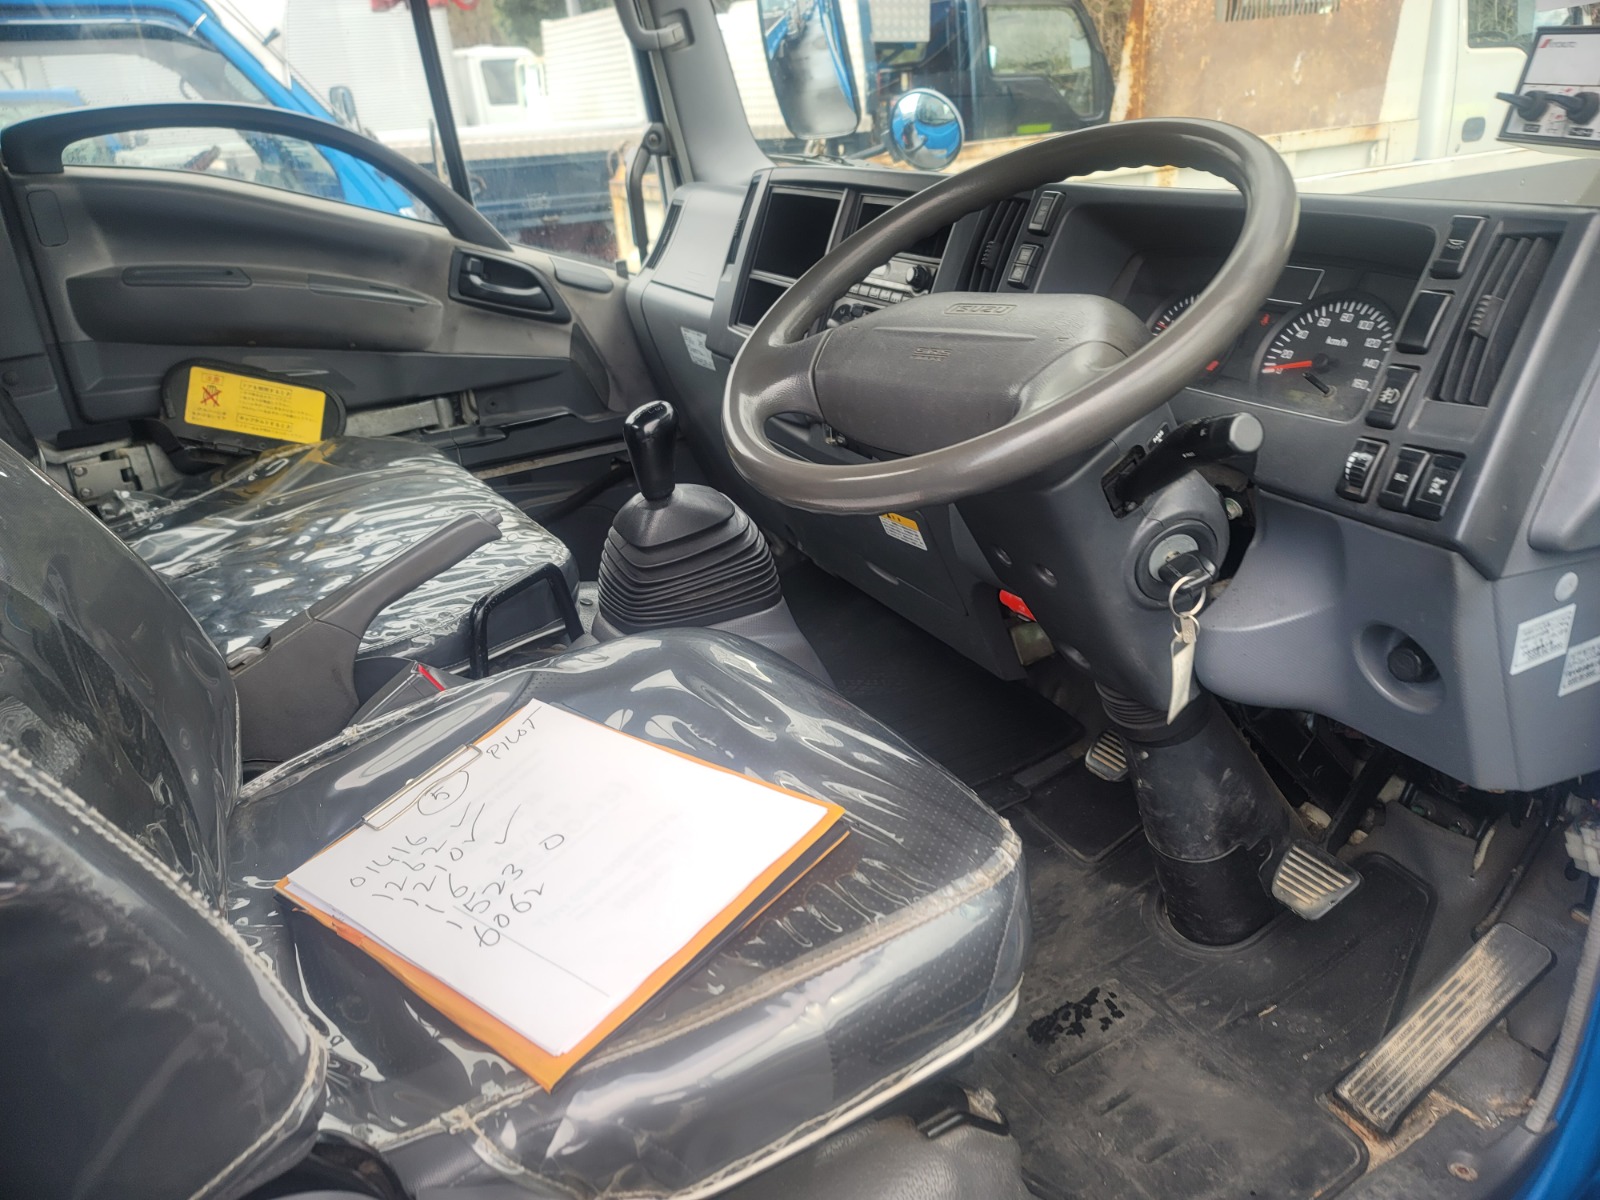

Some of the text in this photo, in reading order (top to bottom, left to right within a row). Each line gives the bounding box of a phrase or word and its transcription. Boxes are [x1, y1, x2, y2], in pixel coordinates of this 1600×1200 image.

[955, 305, 1009, 314] ISUZU
[1317, 318, 1331, 327] 60
[1340, 313, 1354, 322] 80
[1358, 320, 1375, 330] 100
[1326, 336, 1349, 347] km/h
[1280, 349, 1294, 359] 20
[1363, 358, 1380, 369] 140
[1352, 379, 1369, 389] 160
[487, 707, 541, 759] PILOT
